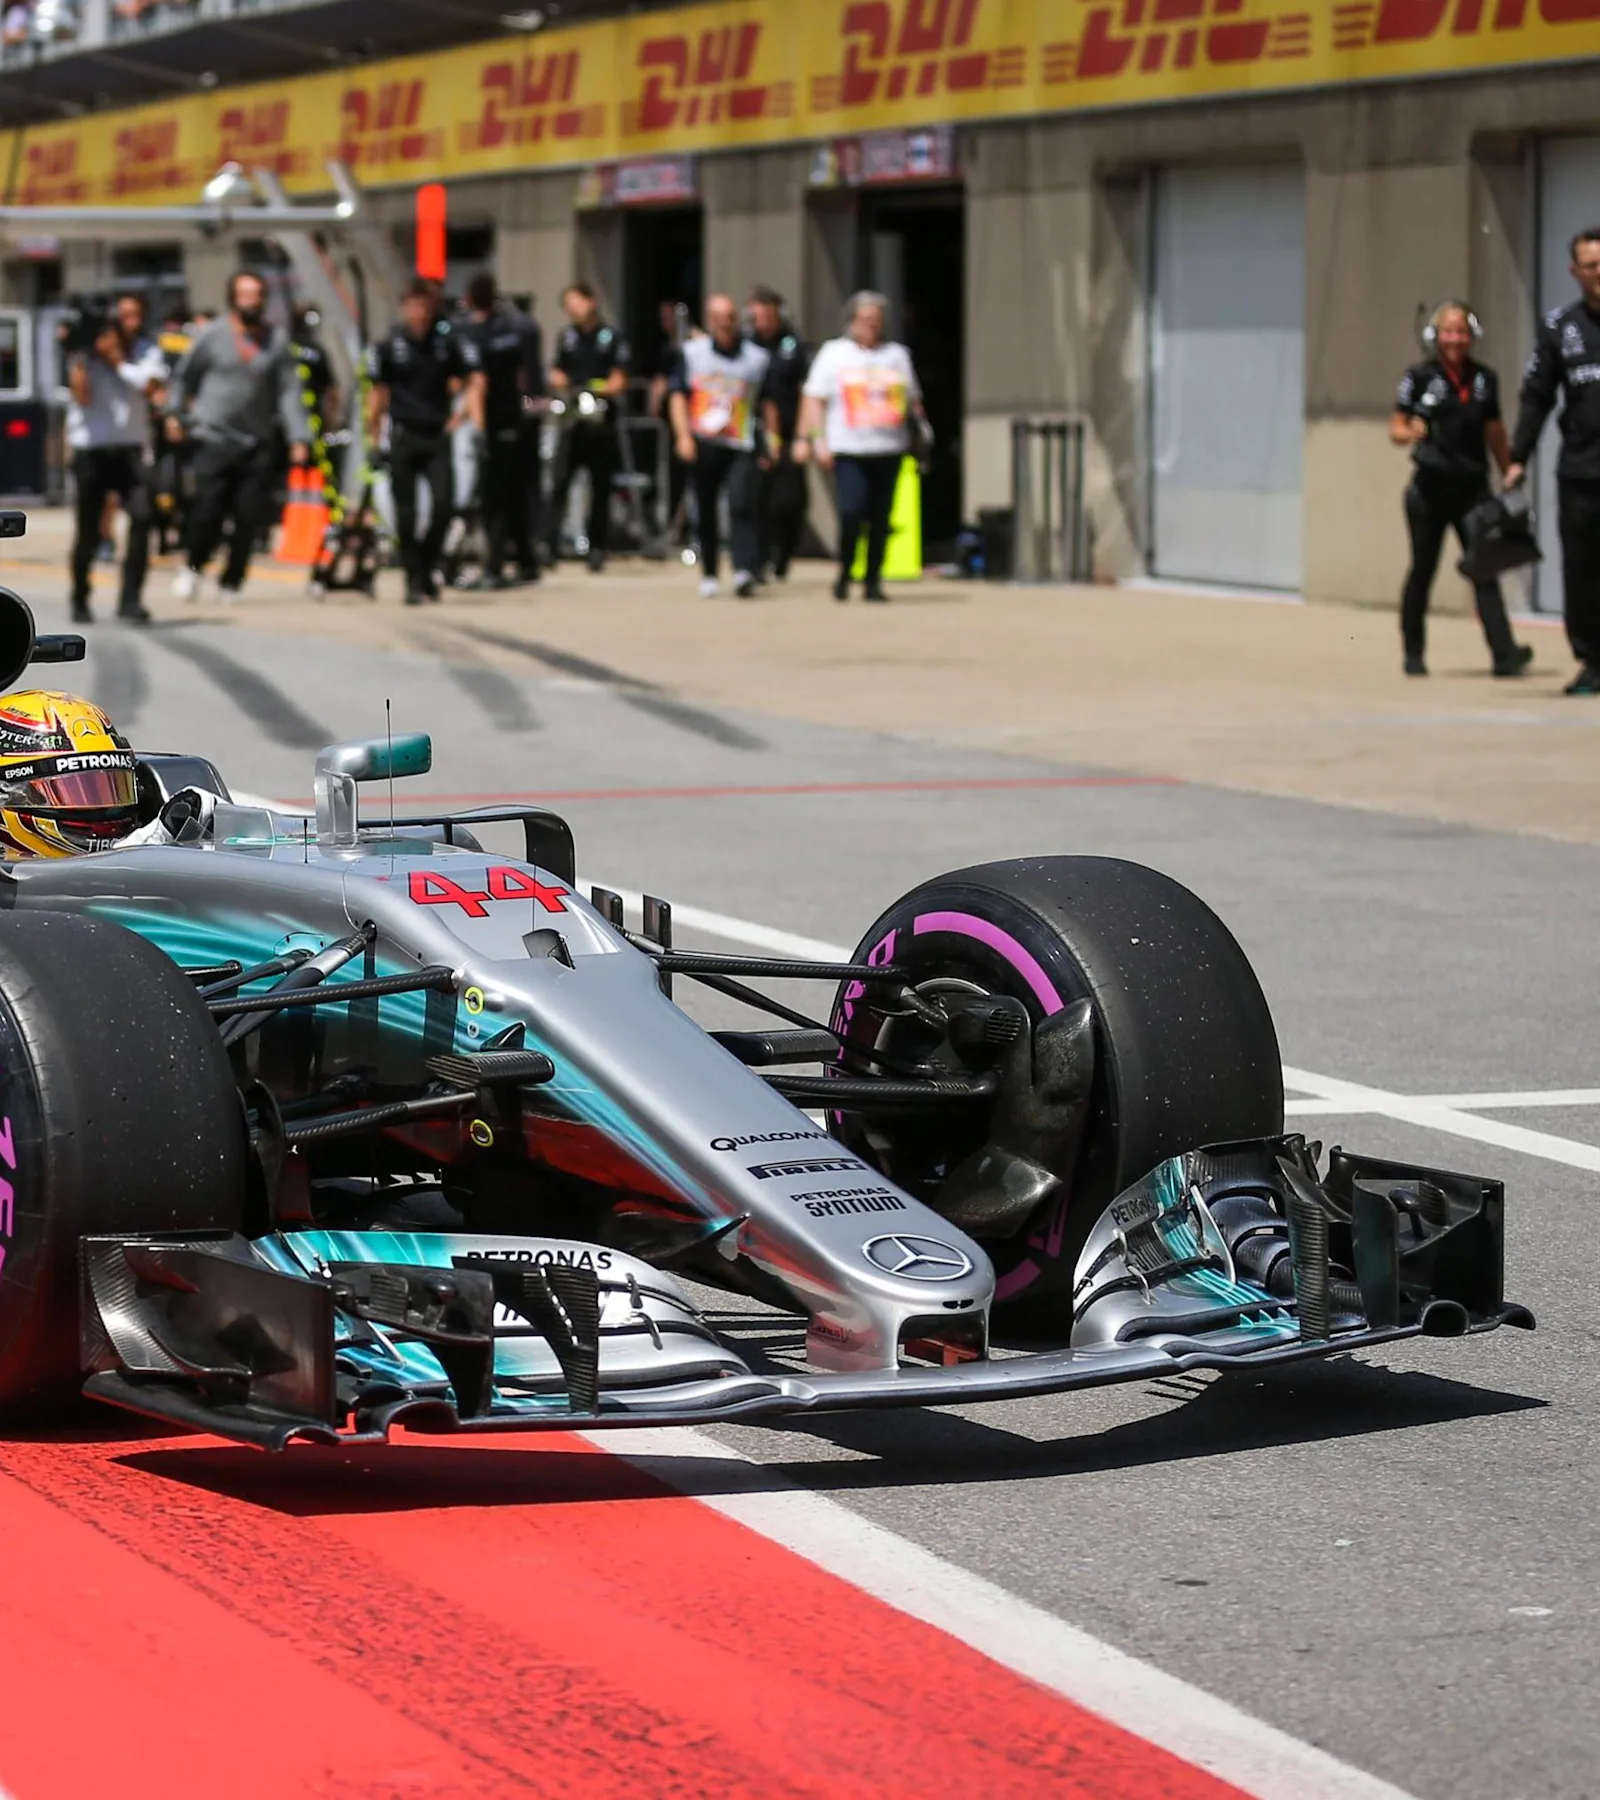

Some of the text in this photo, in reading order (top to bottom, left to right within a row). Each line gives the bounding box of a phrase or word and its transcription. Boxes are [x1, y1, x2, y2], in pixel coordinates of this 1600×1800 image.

[839, 0, 990, 107] DHL
[637, 20, 768, 132] DHL
[477, 48, 583, 148] DHL
[5, 765, 34, 779] EPSON
[56, 753, 133, 772] PETRONAS
[408, 865, 572, 918] 44
[746, 1156, 868, 1181] PIRELLI
[789, 1186, 891, 1203] PETRONAS
[804, 1196, 907, 1218] SYNTIUM
[466, 1249, 613, 1270] RONAS
